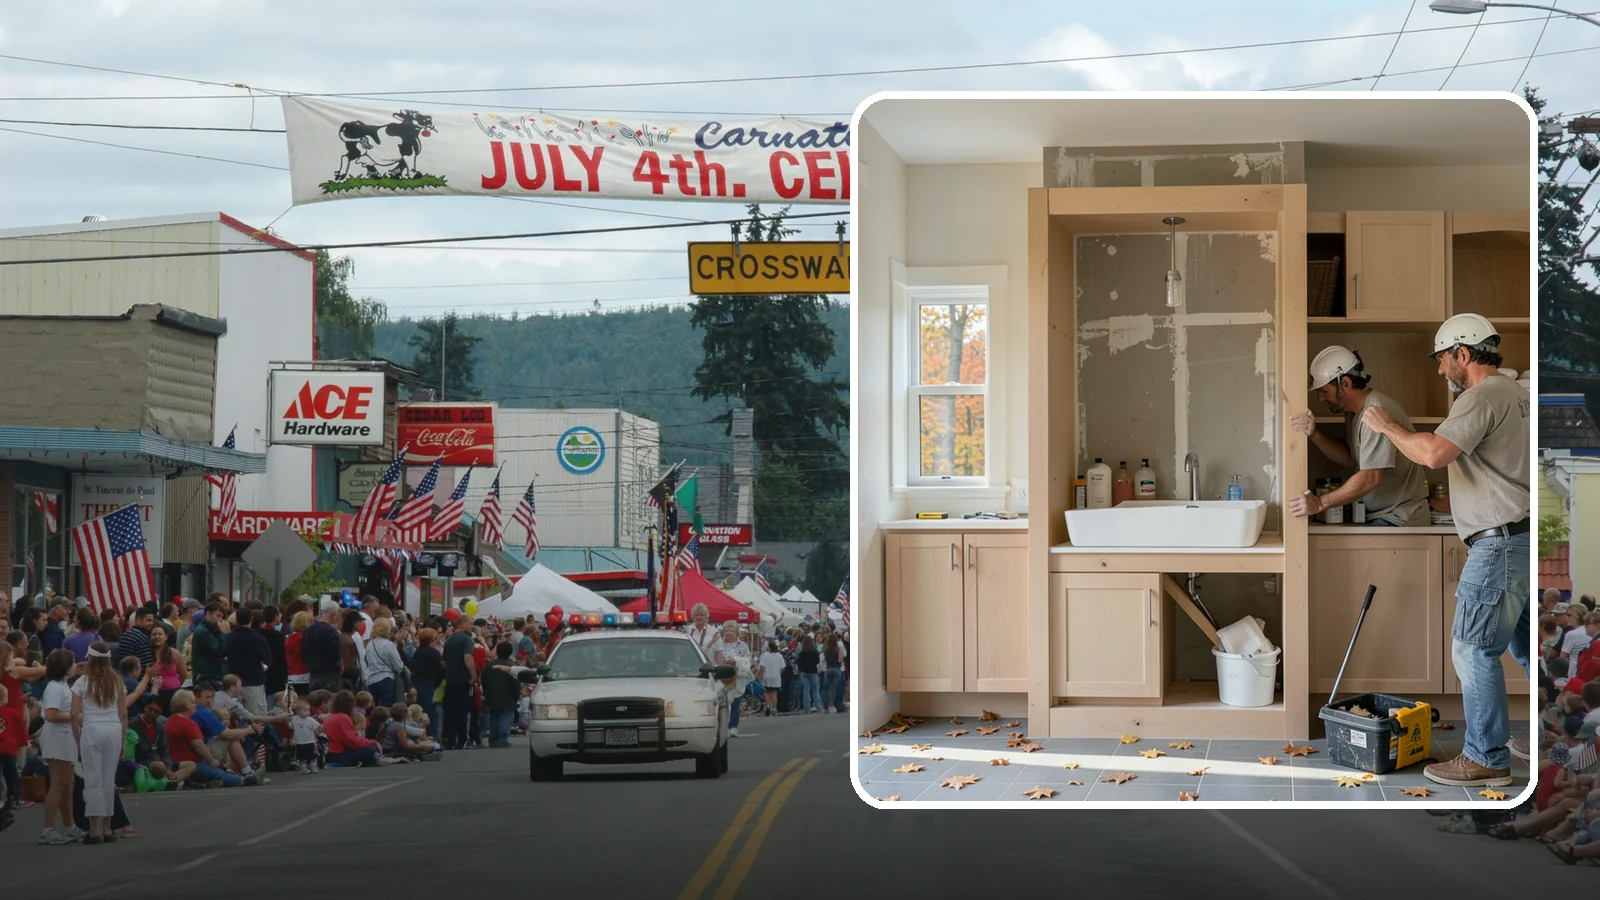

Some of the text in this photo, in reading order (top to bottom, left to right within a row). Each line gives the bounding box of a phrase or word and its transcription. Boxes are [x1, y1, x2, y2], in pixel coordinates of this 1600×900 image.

[695, 121, 850, 150] Carnat
[482, 141, 605, 193] JULY
[632, 150, 746, 198] 4th.
[697, 254, 850, 281] CROSSWA
[283, 380, 373, 419] ACE
[406, 409, 453, 422] CEDAR
[283, 421, 370, 436] Hardware
[416, 428, 477, 447] Coca-Cola
[354, 467, 386, 480] Simpl
[83, 484, 155, 495] St. Vincent de Paul
[81, 503, 153, 522] THT
[688, 526, 741, 535] CRNATION
[699, 535, 730, 544] GLASS
